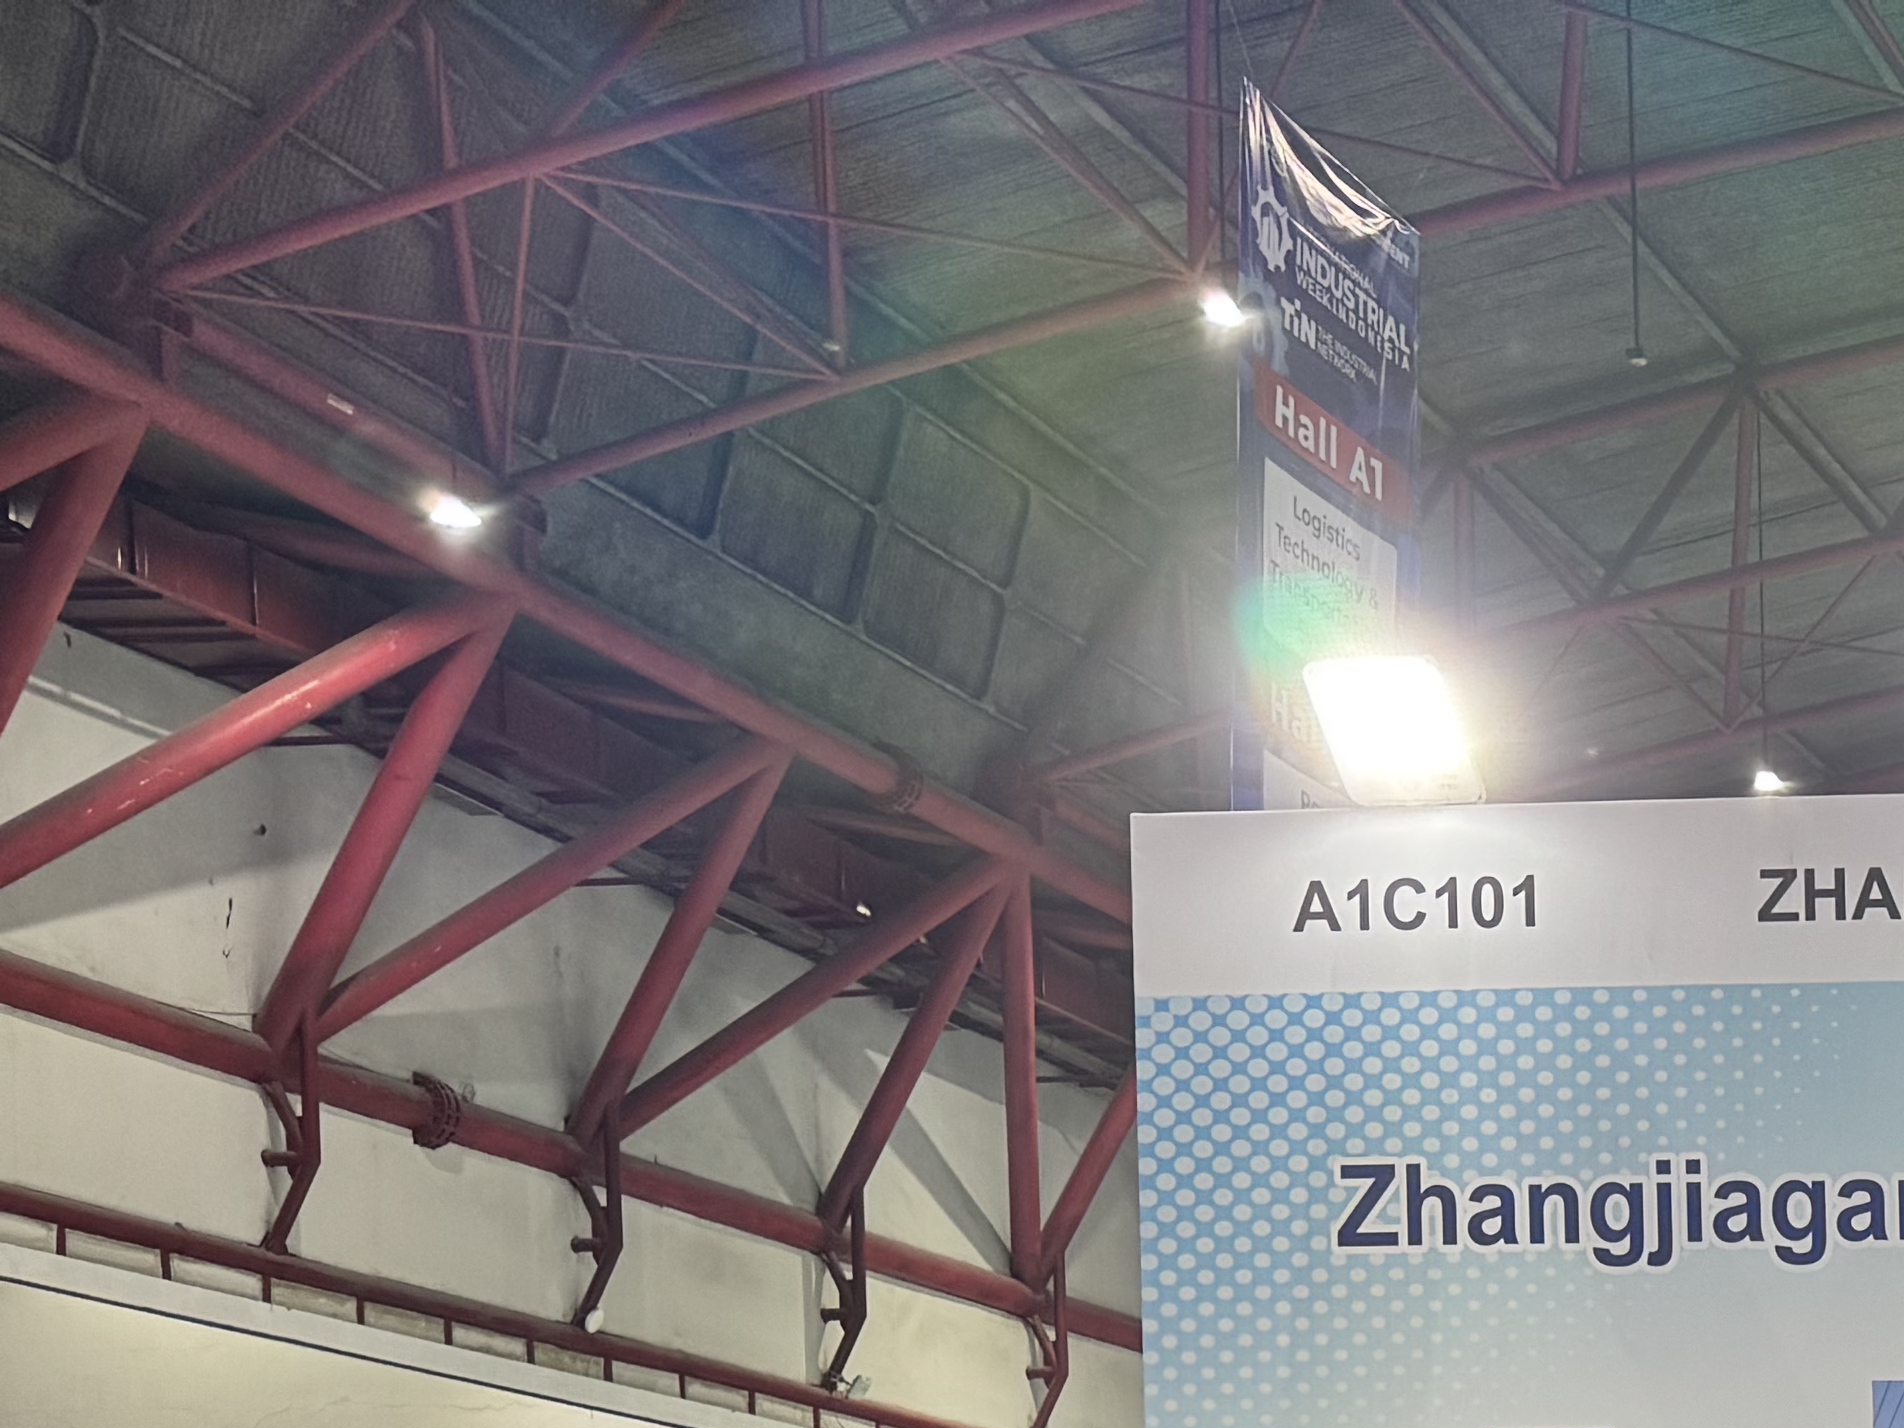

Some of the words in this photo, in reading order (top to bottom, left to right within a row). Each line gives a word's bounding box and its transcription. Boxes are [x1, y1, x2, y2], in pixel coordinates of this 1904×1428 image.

[1296, 237, 1411, 355] INDUSTRIAL
[1332, 299, 1410, 372] INDONESIA
[1275, 384, 1338, 470] Hall
[1350, 446, 1383, 501] A1
[1274, 522, 1364, 604] Technology
[1292, 495, 1362, 563] Logistics
[1292, 873, 1537, 933] A1C101
